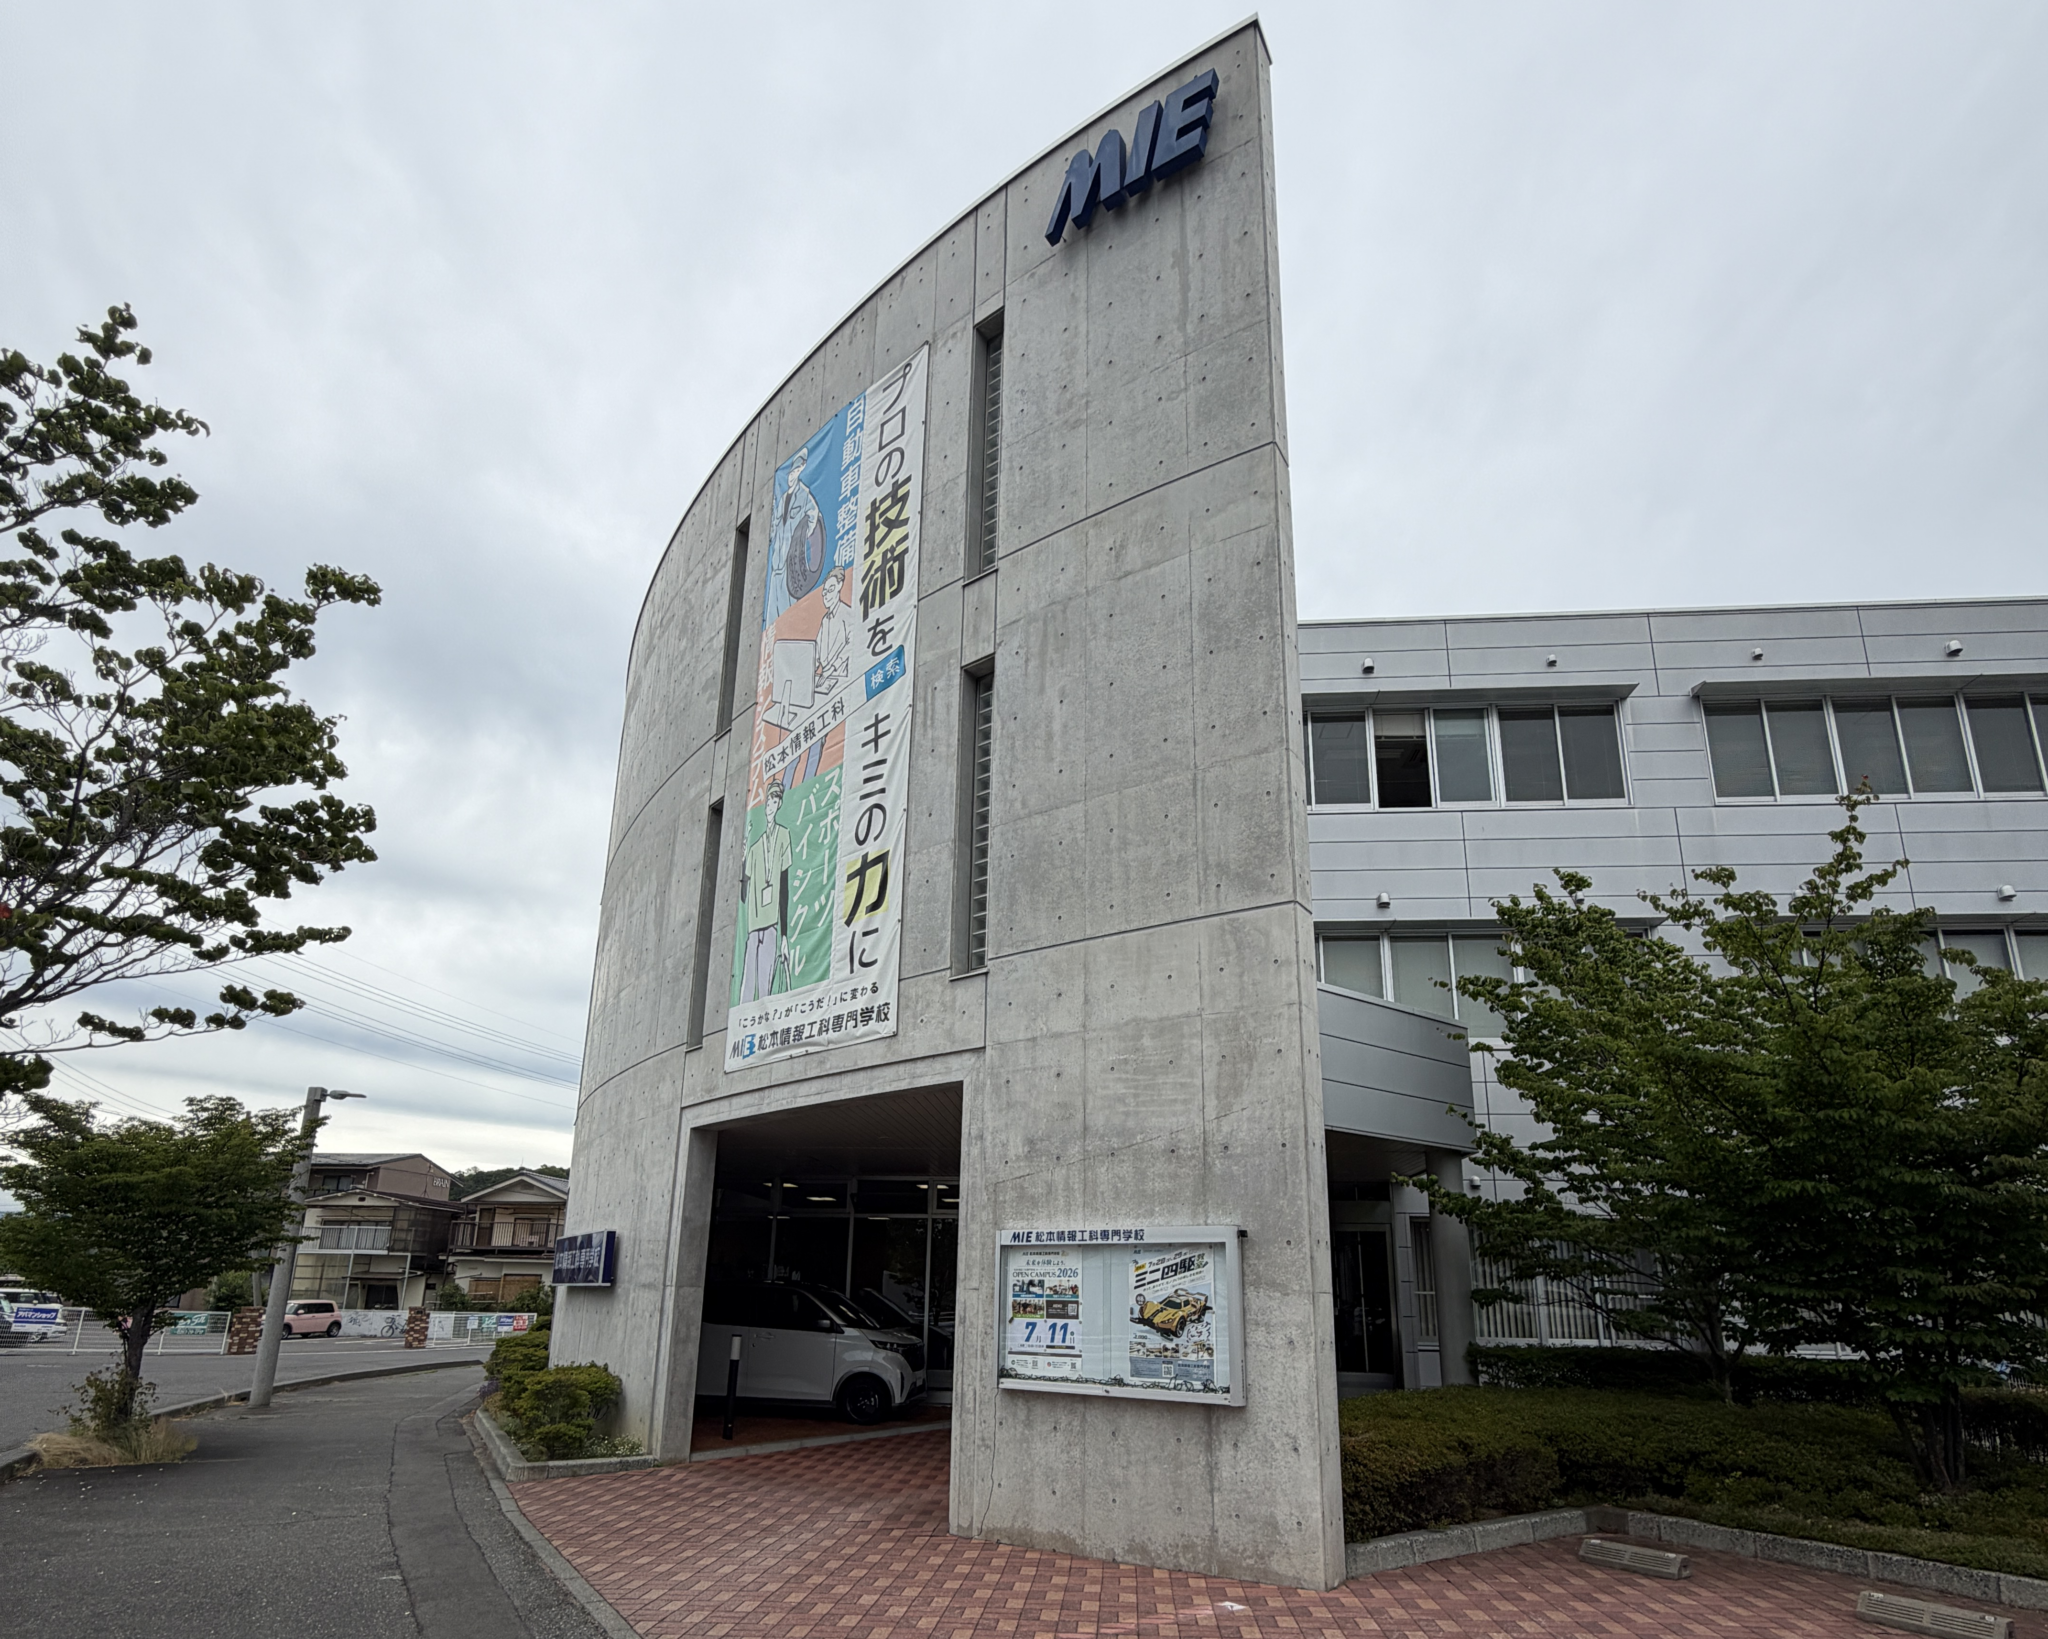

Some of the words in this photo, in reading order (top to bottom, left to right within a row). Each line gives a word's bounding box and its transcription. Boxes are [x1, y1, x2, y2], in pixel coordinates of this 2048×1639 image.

[1044, 67, 1220, 247] MIE
[834, 396, 864, 567] 自動車整備
[859, 362, 912, 657] プロの技術を
[763, 697, 845, 776] 松本情報工科
[870, 657, 900, 690] 検索
[789, 783, 820, 976] バイシクル
[814, 767, 841, 927] スポーツ
[844, 712, 892, 974] キミの力に
[728, 1033, 757, 1060] MIE
[757, 1002, 891, 1052] 松本情報工科専門学校
[1010, 1231, 1033, 1243] MIE
[1035, 1229, 1145, 1243] 松本情報工科専門学校
[1057, 1267, 1079, 1278] 2026
